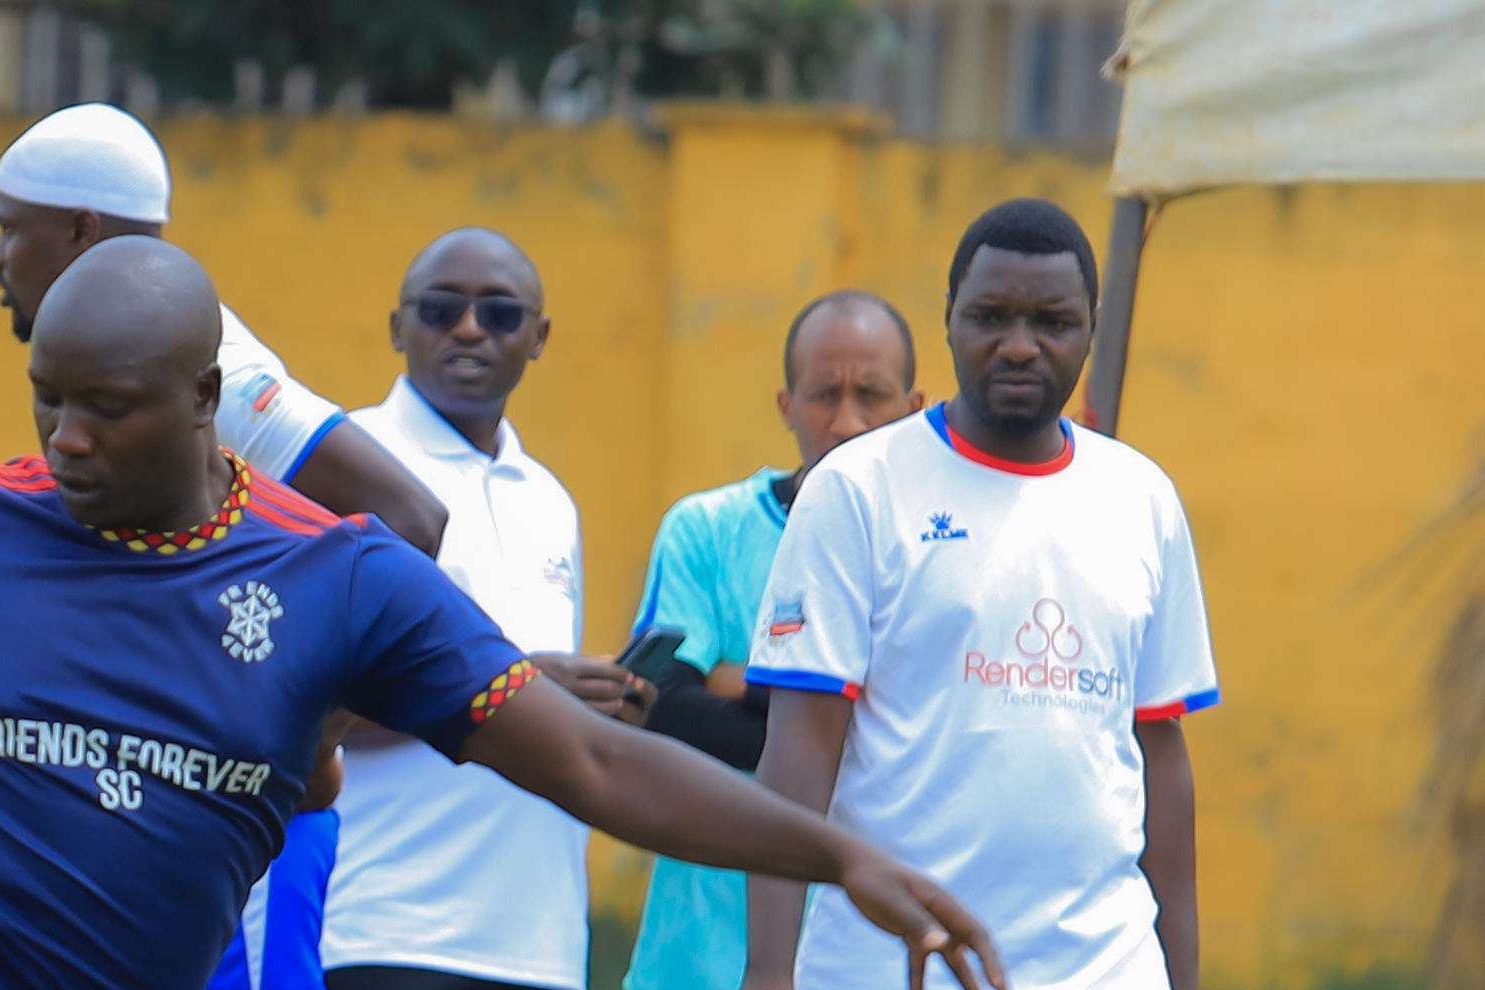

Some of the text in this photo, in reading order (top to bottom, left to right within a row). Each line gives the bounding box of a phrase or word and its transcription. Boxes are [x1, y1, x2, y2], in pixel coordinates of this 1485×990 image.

[964, 651, 1123, 700] Rendersoft
[95, 768, 144, 811] SC
[117, 734, 272, 796] FOREVER
